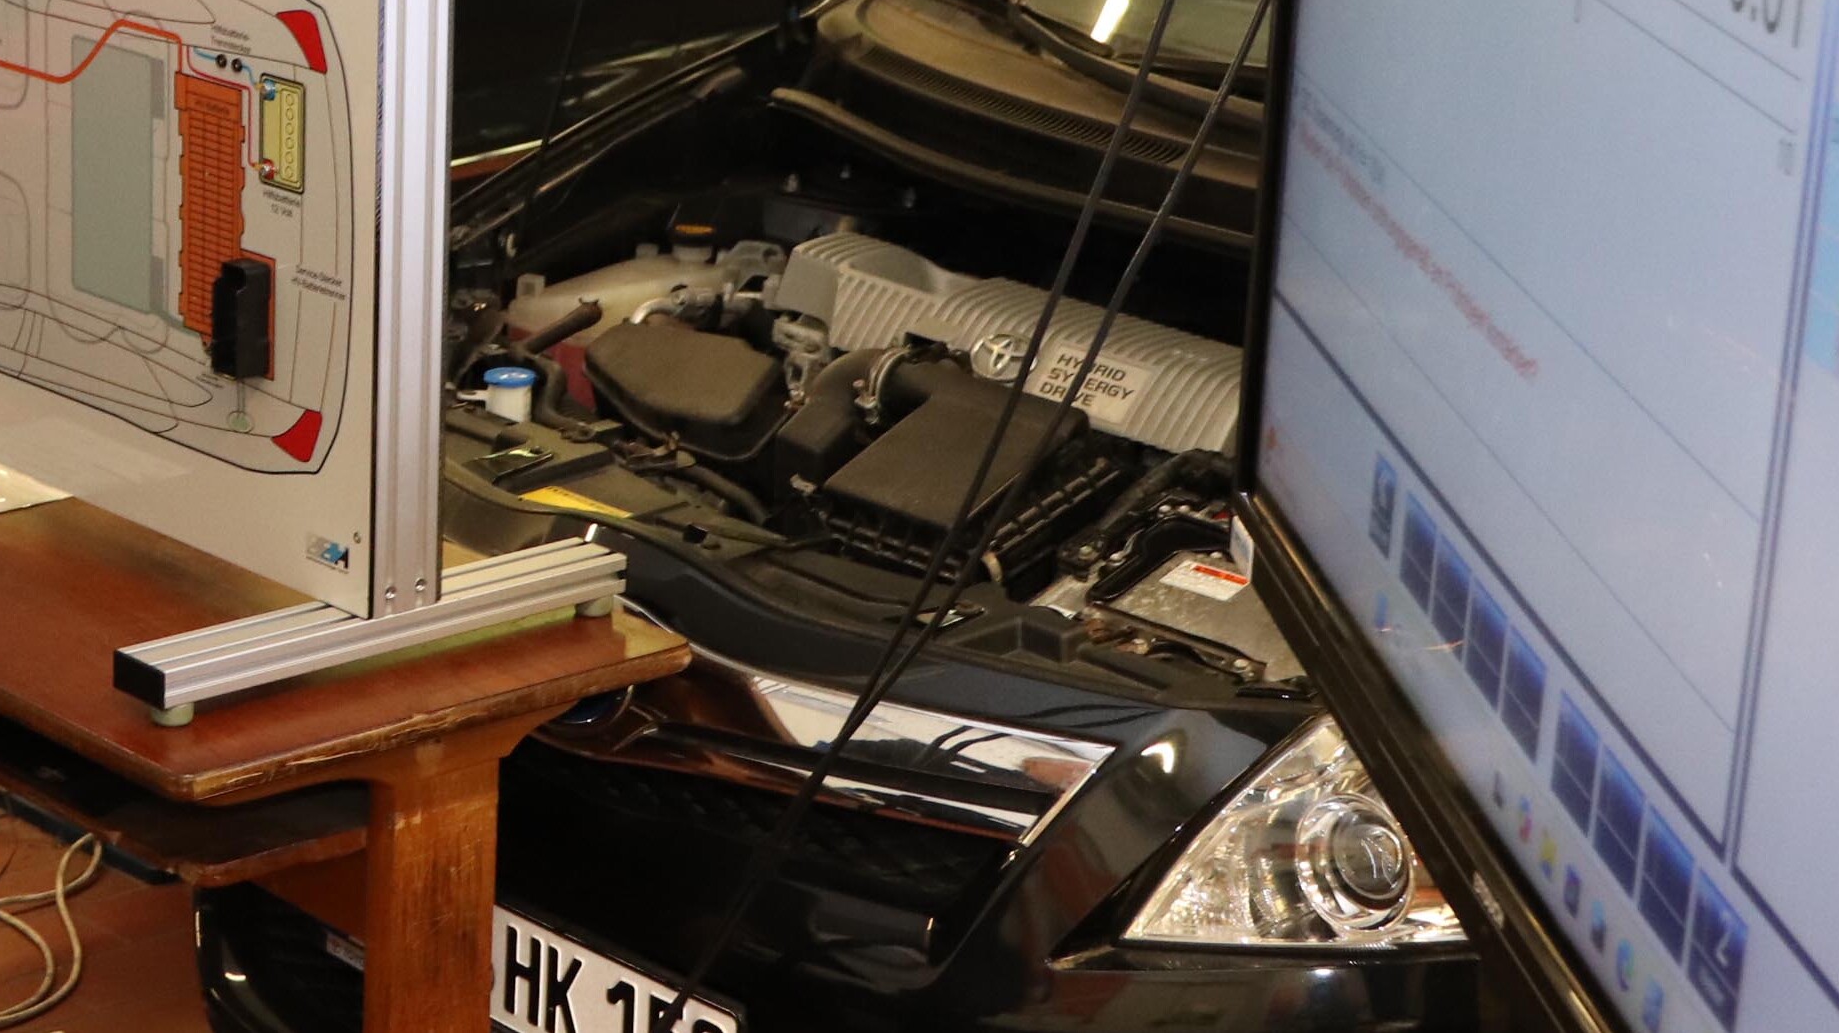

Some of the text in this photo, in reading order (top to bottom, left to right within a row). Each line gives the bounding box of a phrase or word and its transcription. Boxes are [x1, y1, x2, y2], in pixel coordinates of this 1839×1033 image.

[1056, 353, 1126, 382] HYRID
[1039, 381, 1096, 407] DRVE
[1048, 367, 1135, 400] SYERGY
